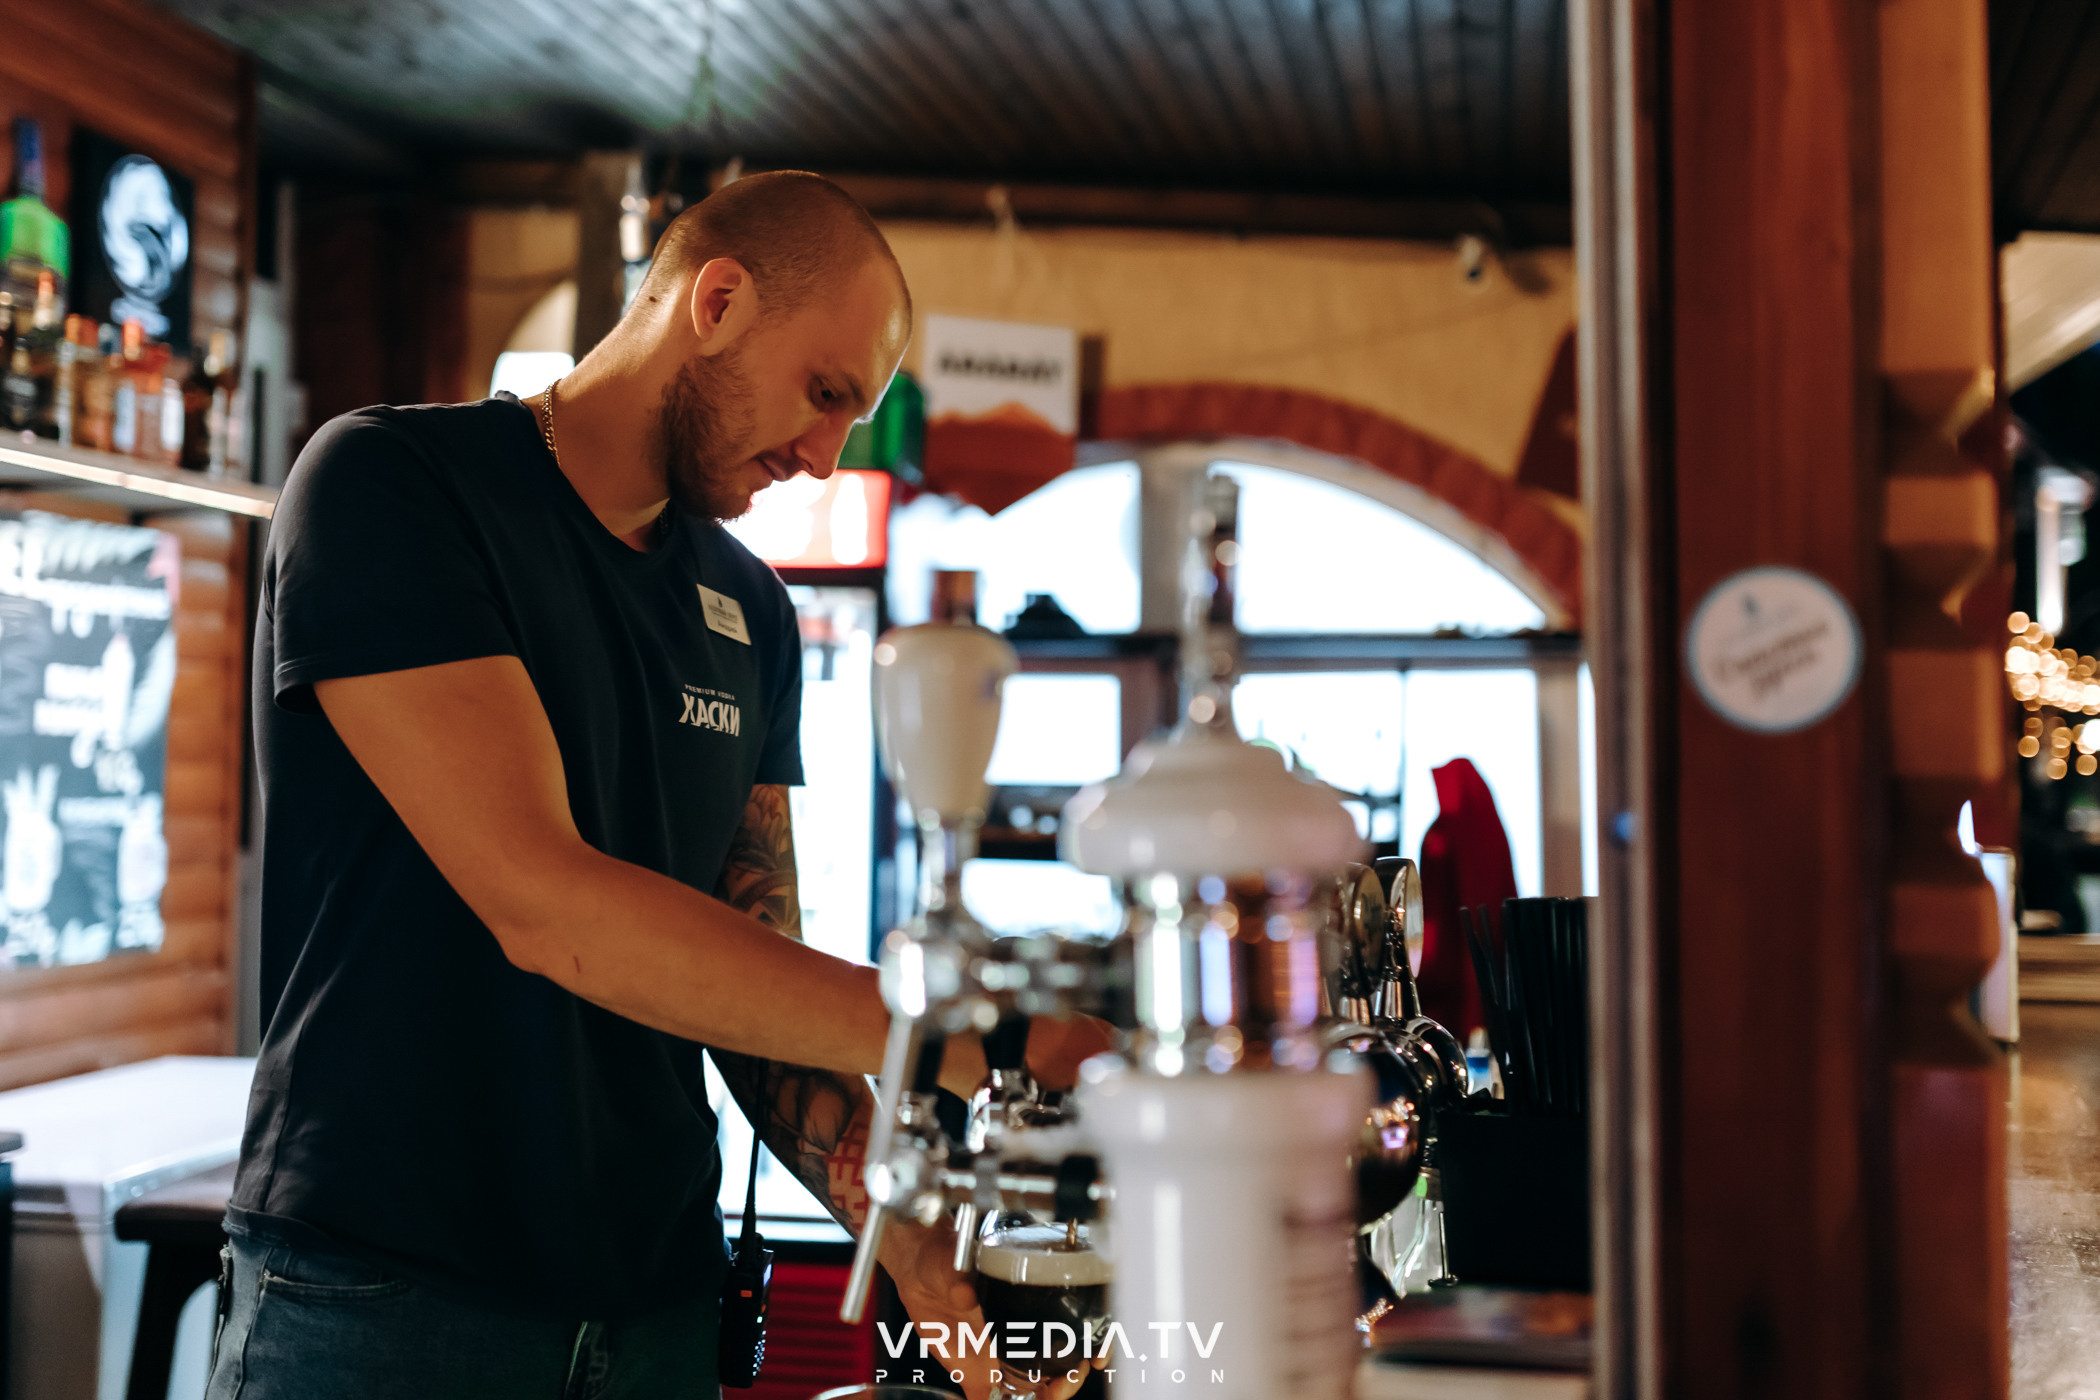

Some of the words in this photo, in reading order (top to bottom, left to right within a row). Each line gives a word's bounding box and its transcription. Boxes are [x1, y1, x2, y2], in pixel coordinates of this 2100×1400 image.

[684, 684, 715, 696] PREMIUM
[717, 691, 736, 701] VODKA
[678, 693, 740, 737] ХАСКИ
